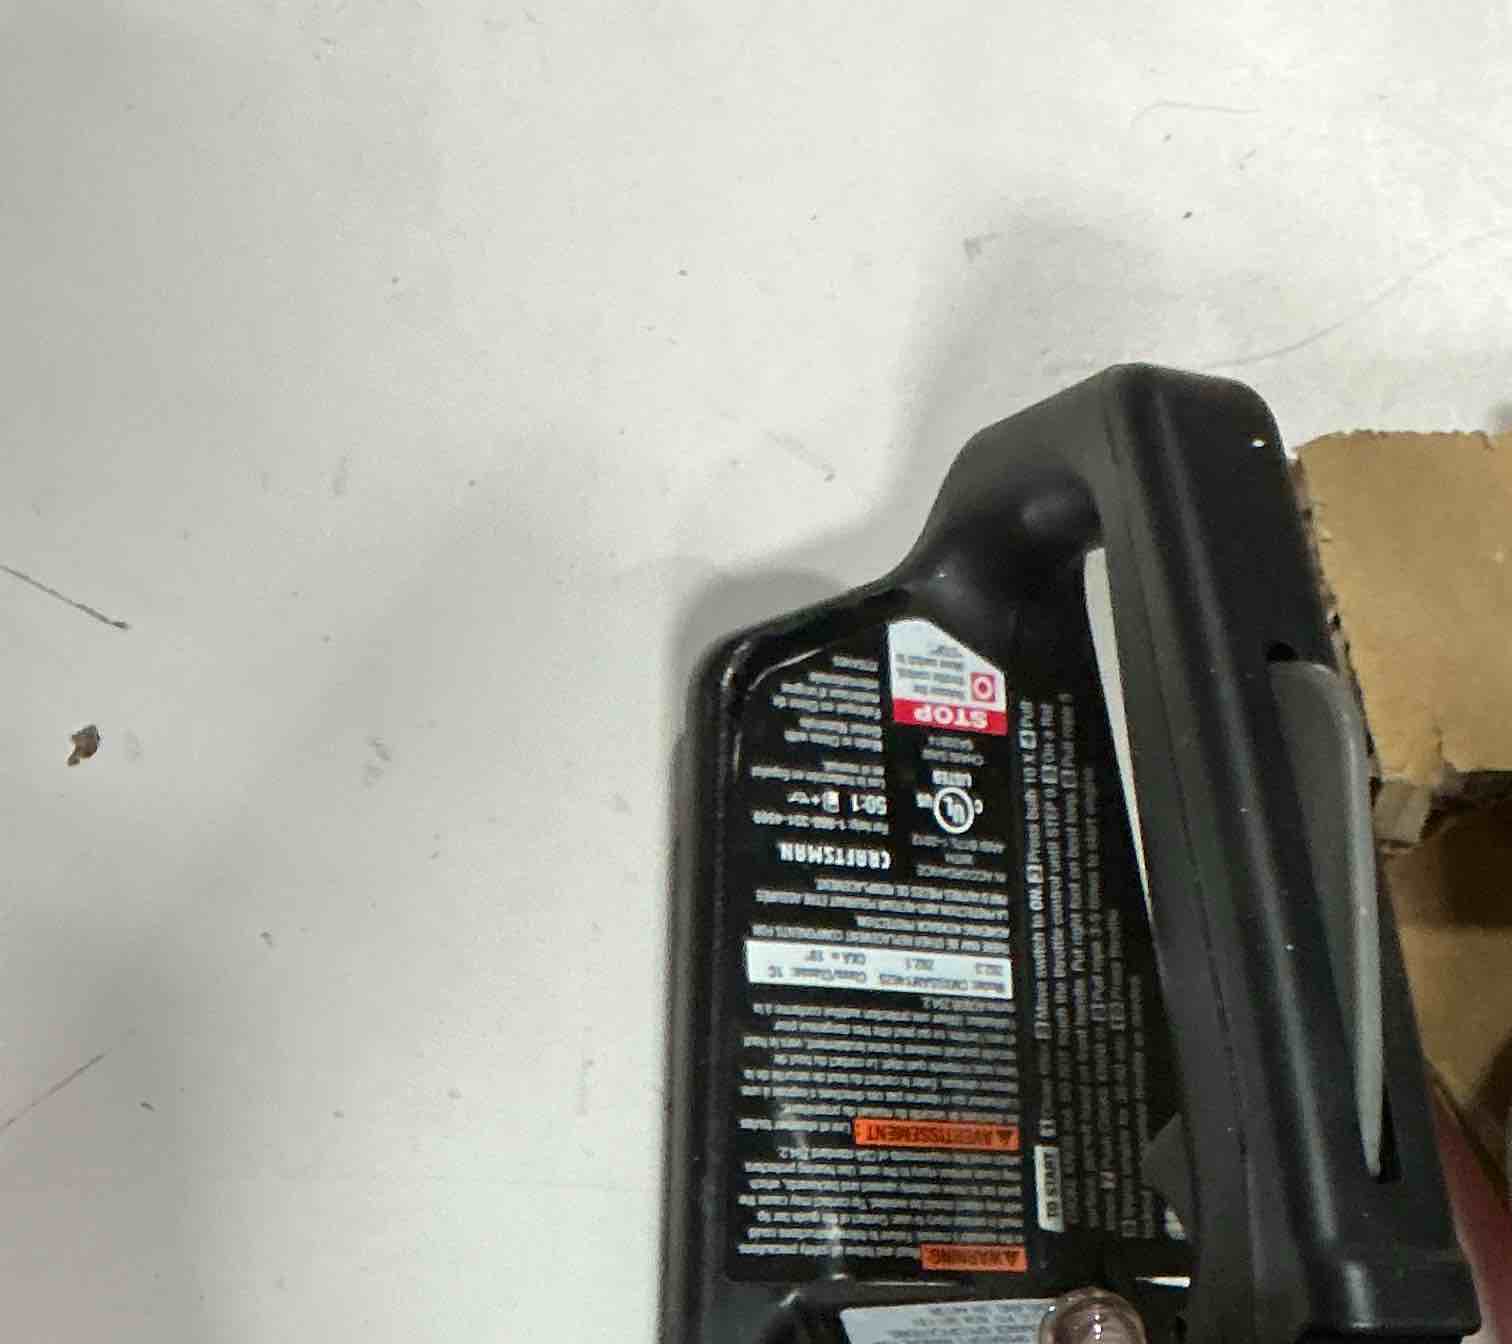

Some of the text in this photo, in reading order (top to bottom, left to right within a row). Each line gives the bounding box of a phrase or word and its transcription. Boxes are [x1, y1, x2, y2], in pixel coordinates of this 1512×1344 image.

[913, 705, 988, 728] STOP
[850, 794, 887, 815] 50:1
[778, 842, 891, 869] CRAFTSMAN
[1031, 913, 1045, 928] to
[1031, 931, 1048, 978] switch
[865, 1125, 992, 1145] AVERTISSEMENT
[1043, 1151, 1057, 1198] START
[1046, 1200, 1058, 1219] TO
[929, 1249, 1001, 1266] WARNING
